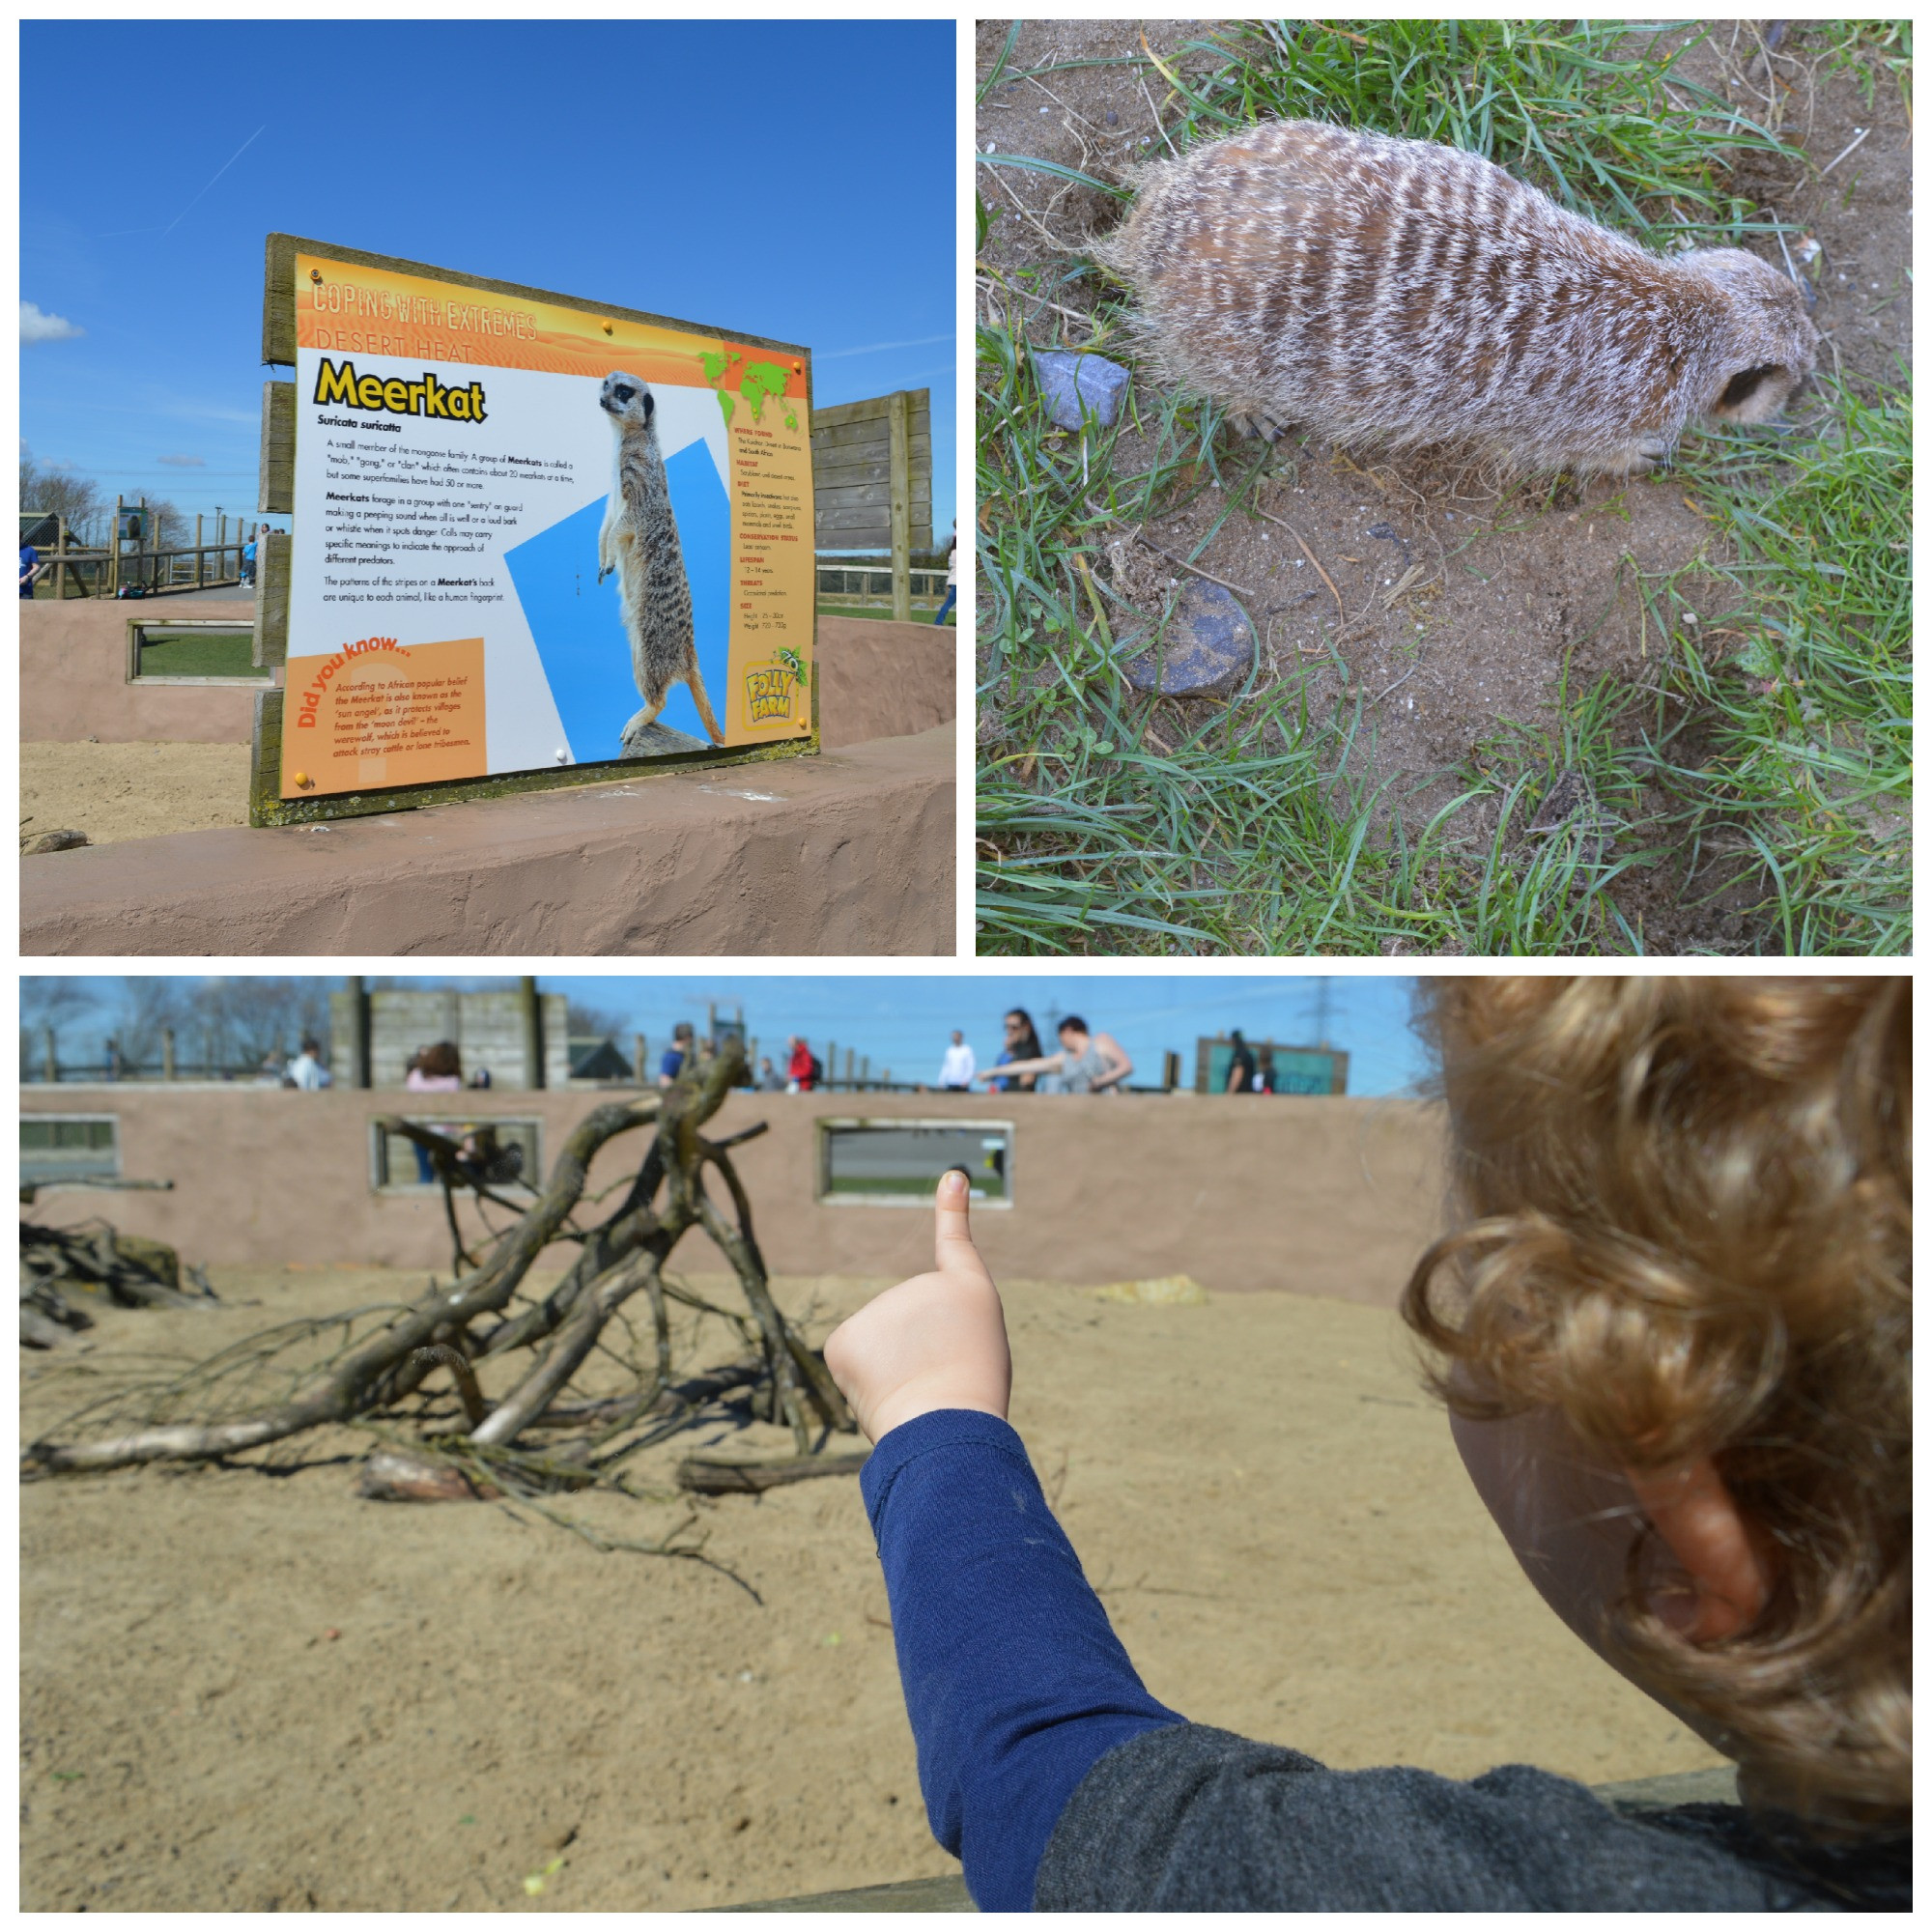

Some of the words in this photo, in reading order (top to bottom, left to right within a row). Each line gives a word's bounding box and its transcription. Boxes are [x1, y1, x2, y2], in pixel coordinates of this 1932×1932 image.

[313, 283, 392, 320] COPING
[396, 295, 441, 326] WITH
[446, 302, 537, 341] EXTREMES
[316, 328, 405, 356] DESERT
[417, 339, 471, 363] HEAT
[314, 357, 488, 424] Meerkat
[318, 414, 357, 428] Suricata
[360, 420, 401, 433] suricatta
[336, 440, 355, 449] small
[357, 442, 387, 452] member
[389, 444, 397, 453] of
[399, 445, 409, 454] the
[412, 448, 445, 458] mongoose
[478, 455, 497, 464] group
[508, 456, 542, 467] Meerkats
[550, 461, 567, 469] called
[327, 469, 338, 478] but
[363, 473, 409, 484] superfamilies
[412, 475, 428, 485] have
[430, 476, 443, 486] had
[421, 462, 441, 471] which
[443, 464, 460, 472] often
[490, 468, 507, 477] about
[520, 471, 545, 481] meerkats
[326, 492, 369, 502] Meerkats
[372, 494, 395, 506] forage
[413, 498, 435, 508] group
[504, 503, 523, 512] guard
[326, 507, 354, 520] making
[363, 510, 393, 521] peeping
[418, 512, 437, 521] when
[336, 524, 361, 533] whistle
[363, 525, 384, 533] when
[393, 527, 410, 536] spots
[475, 531, 493, 540] carry
[326, 539, 354, 550] specific
[355, 541, 390, 551] meanings
[402, 541, 429, 551] indicate
[432, 542, 441, 551] the
[443, 543, 475, 553] approach
[325, 554, 355, 564] different
[358, 555, 395, 565] predators.
[325, 576, 337, 585] The
[340, 577, 369, 587] patterns
[372, 577, 380, 585] of
[382, 577, 393, 585] the
[395, 578, 417, 588] stripes
[479, 578, 495, 586] back
[339, 593, 364, 603] unique
[376, 592, 393, 601] each
[396, 592, 421, 602] animal,
[424, 592, 436, 601] like
[445, 592, 468, 601] human
[298, 692, 320, 727] Did
[312, 653, 345, 693] you
[343, 637, 412, 659] know...
[336, 682, 375, 692] According
[387, 679, 414, 689] African
[417, 677, 445, 689] popular
[447, 676, 469, 685] belief
[747, 669, 796, 703] FOLLY
[335, 696, 349, 705] the
[351, 695, 384, 703] Meerkat
[394, 693, 410, 701] also
[412, 692, 438, 700] known
[450, 690, 462, 698] the
[395, 705, 401, 714] it
[403, 704, 432, 716] protects
[435, 702, 461, 712] villages
[752, 696, 790, 723] FARM
[334, 722, 354, 730] from
[355, 721, 368, 729] the
[334, 734, 375, 744] werewolf,
[378, 730, 399, 741] which
[402, 730, 408, 739] is
[411, 729, 440, 738] believed
[333, 749, 358, 757] attack
[360, 747, 382, 755] stray
[384, 744, 403, 753] cattle
[416, 742, 432, 751] lone
[434, 739, 470, 749] tribesmen.
